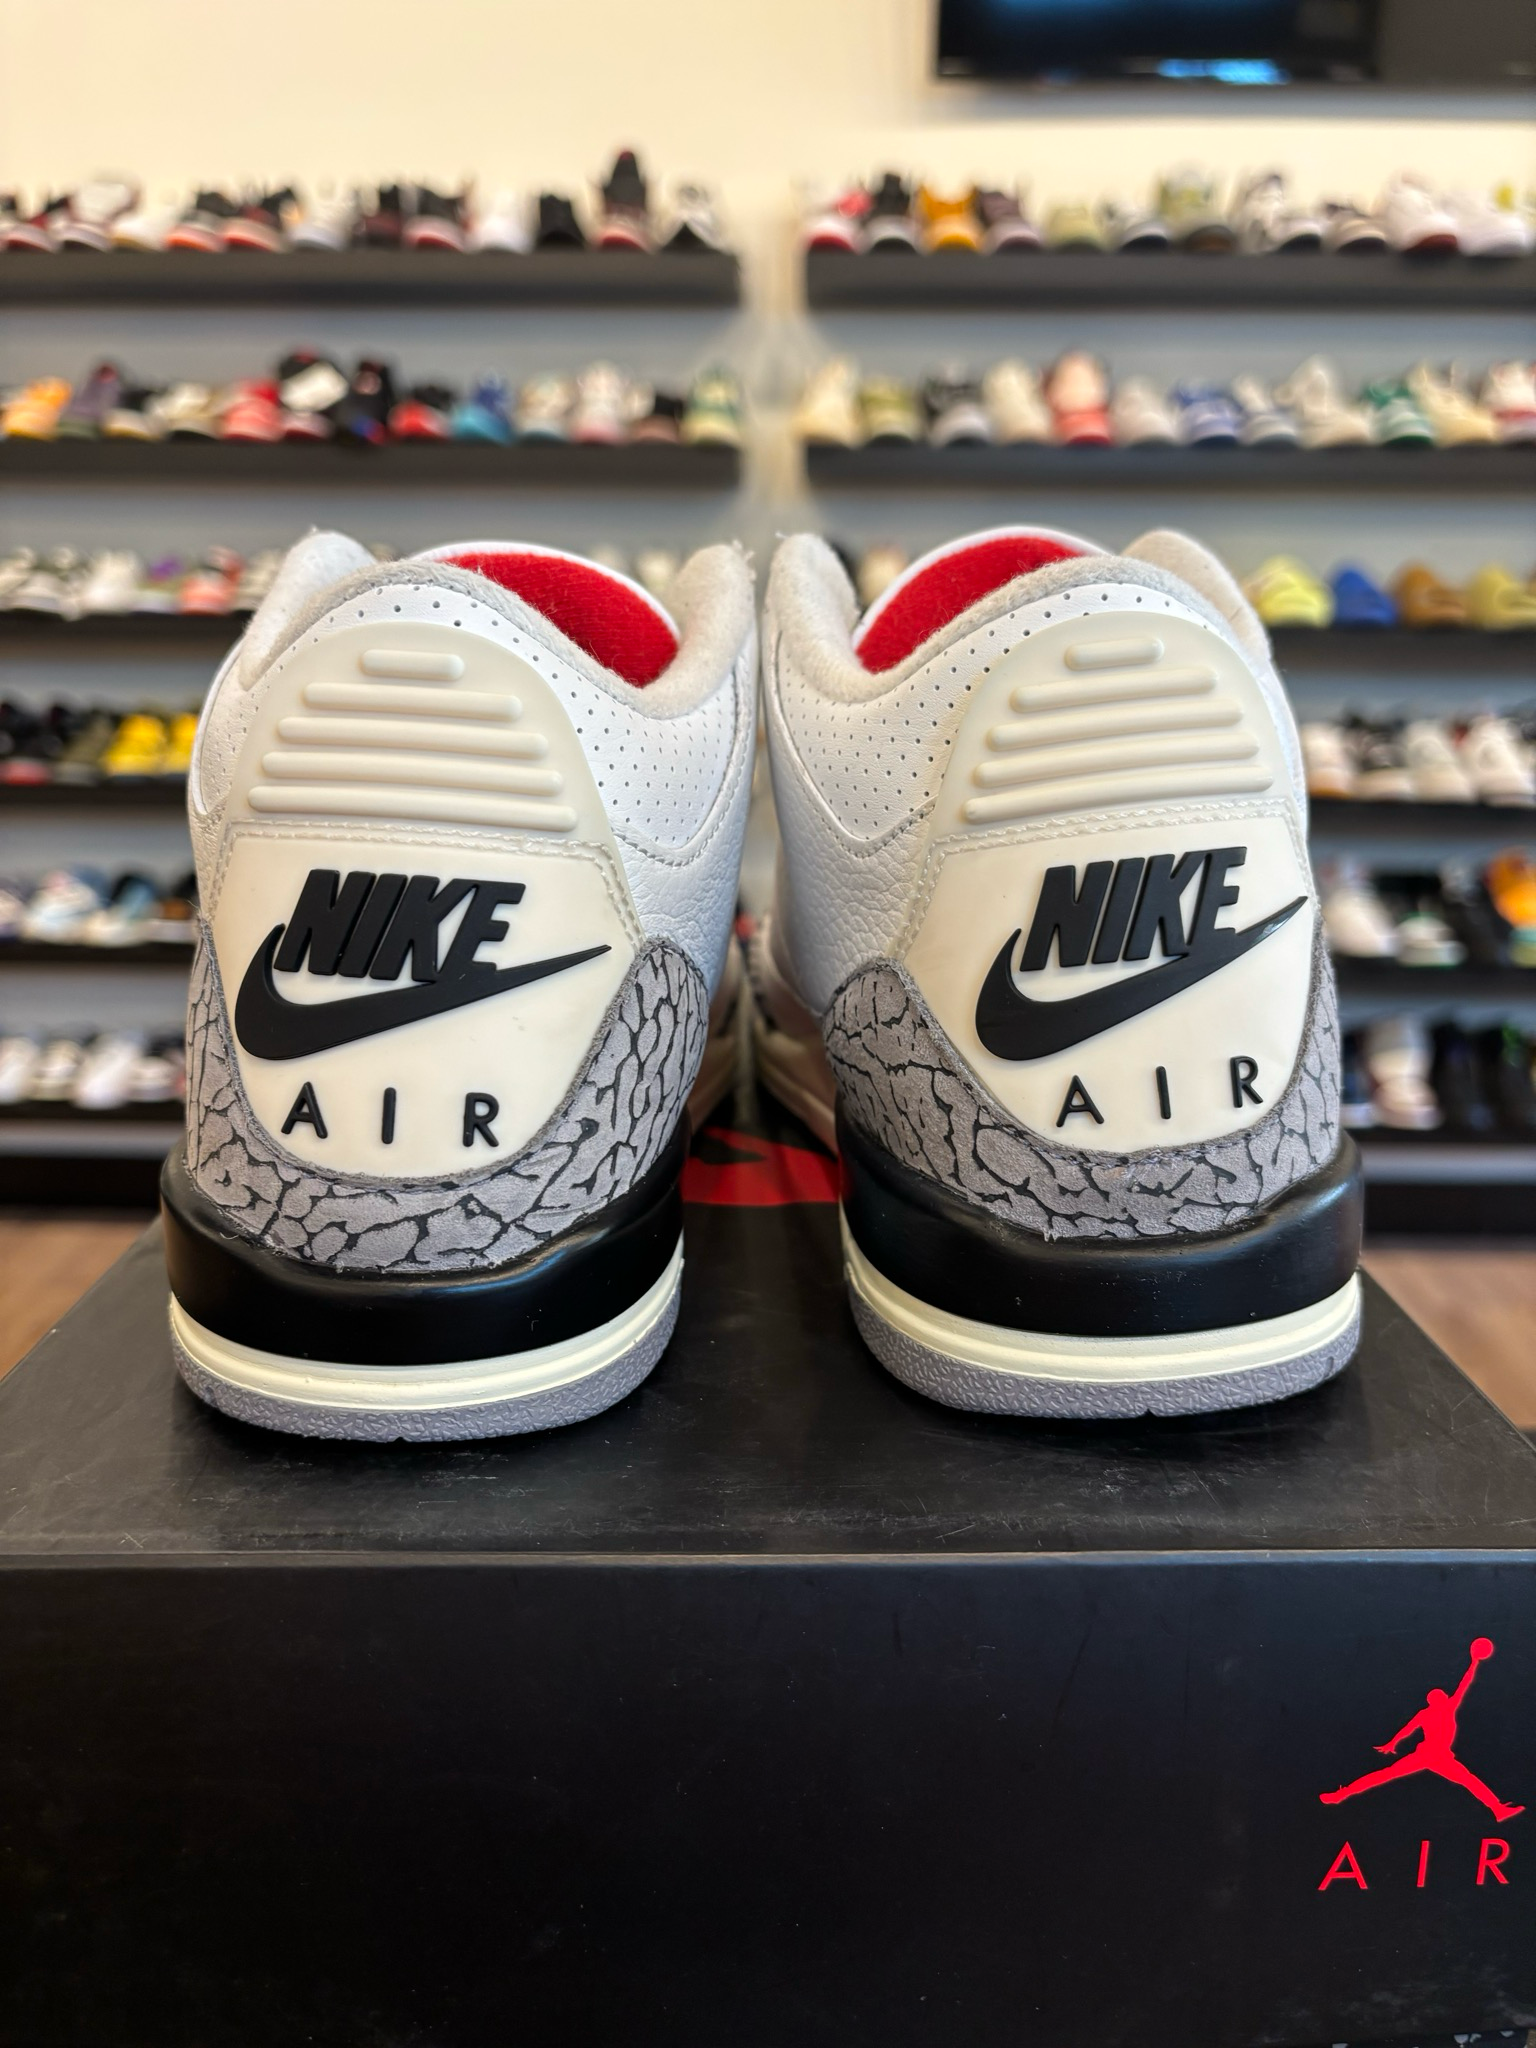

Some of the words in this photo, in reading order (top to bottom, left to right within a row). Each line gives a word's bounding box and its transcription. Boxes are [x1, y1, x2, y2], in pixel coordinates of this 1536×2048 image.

[273, 868, 527, 982] NIKE
[1019, 846, 1248, 973] NIKE
[281, 1081, 501, 1148] AIR
[1056, 1055, 1264, 1128] AIR
[1317, 1838, 1510, 1891] AIR
